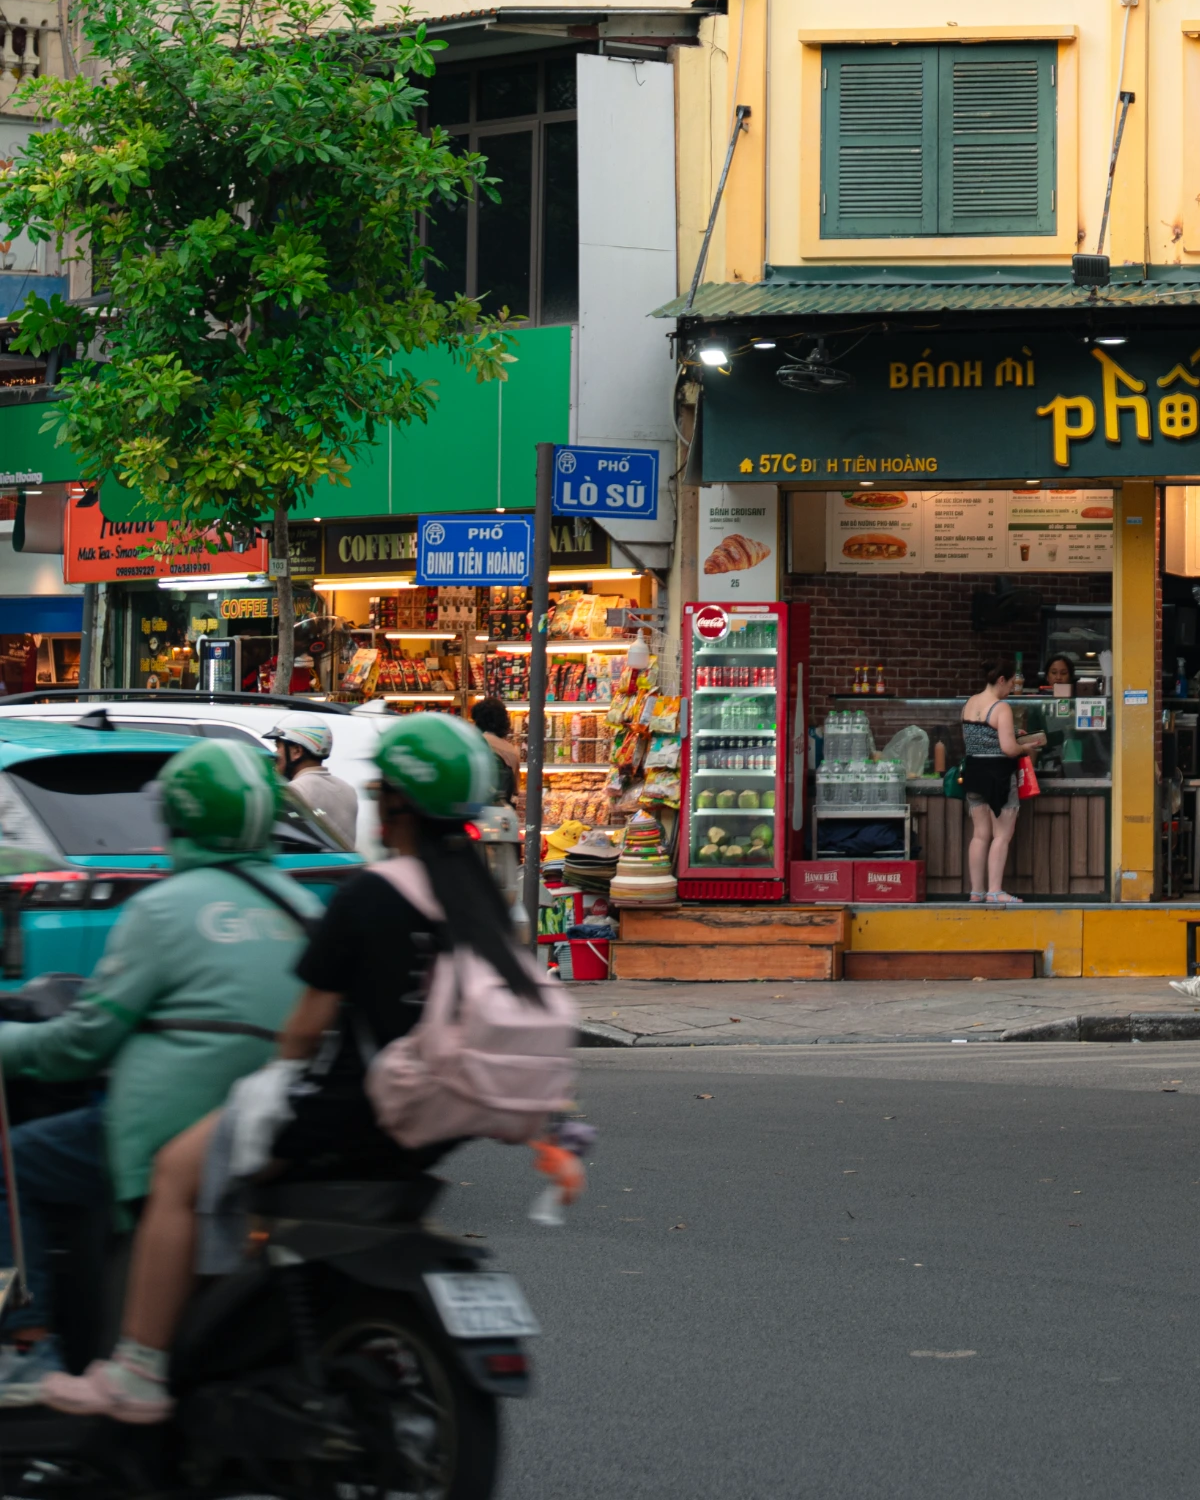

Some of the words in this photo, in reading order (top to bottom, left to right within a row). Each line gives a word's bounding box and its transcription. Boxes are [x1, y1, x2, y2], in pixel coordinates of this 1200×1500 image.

[889, 348, 983, 389] BÁNH
[995, 346, 1035, 387] MÌ
[598, 455, 631, 473] PHỐ
[758, 453, 798, 474] 57C
[842, 454, 877, 474] TIÊN
[880, 453, 938, 473] HOÀNG
[562, 476, 598, 506] LÒ
[606, 480, 646, 509] SŨ
[731, 507, 766, 516] CROISANT
[468, 522, 504, 541] PHỐ
[427, 550, 453, 575] ĐINH
[458, 547, 484, 575] TIÊN
[486, 546, 525, 575] HOÀNG
[731, 579, 740, 588] 25
[221, 598, 268, 619] COFFEE
[805, 871, 823, 883] HANOI
[824, 871, 838, 882] BEER
[868, 872, 886, 884] HANOI
[887, 871, 902, 884] BEER
